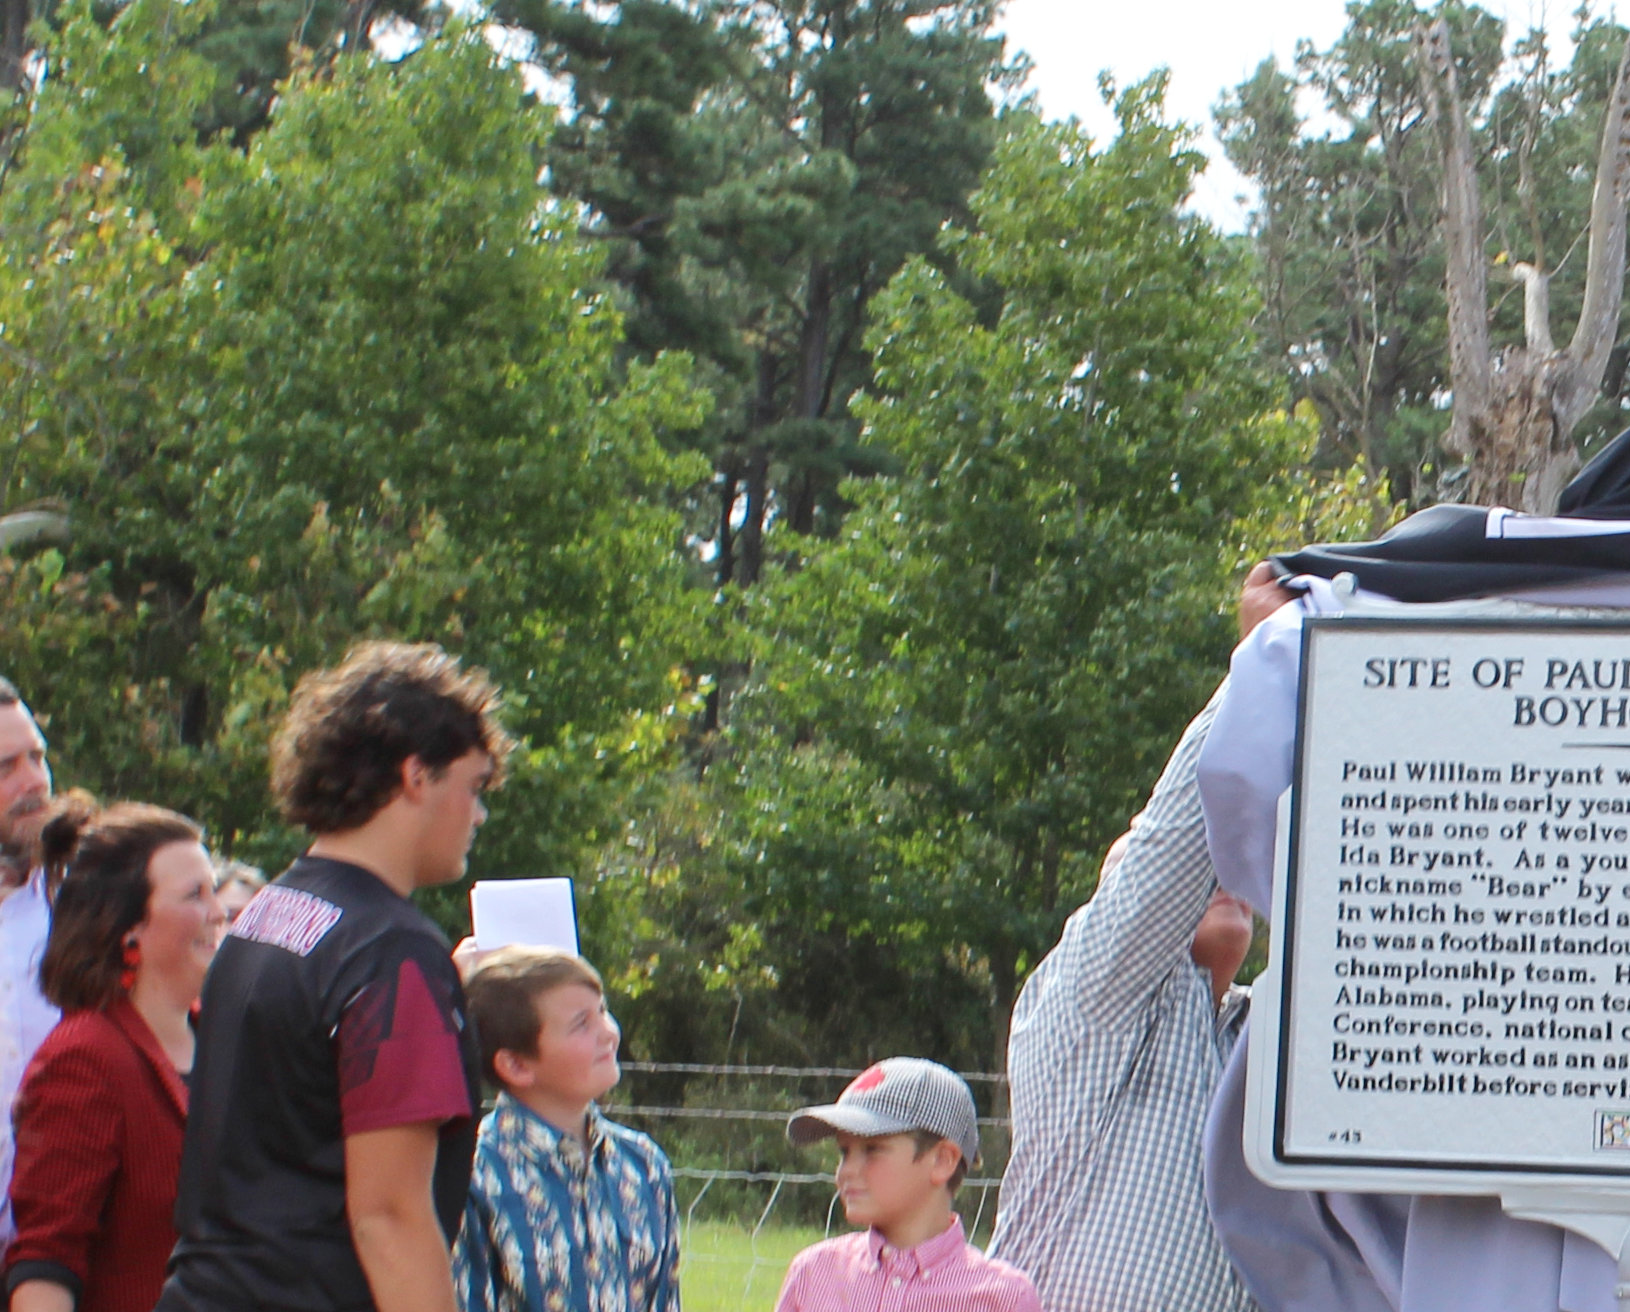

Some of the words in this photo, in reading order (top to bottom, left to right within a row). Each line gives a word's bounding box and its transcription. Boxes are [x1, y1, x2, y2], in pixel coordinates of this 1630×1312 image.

[1363, 656, 1450, 689] SITE
[1472, 657, 1524, 690] OF
[1342, 760, 1396, 782] Paul
[1405, 760, 1501, 784] William
[1510, 762, 1604, 790] Bryant
[1341, 789, 1386, 811] and
[1390, 790, 1459, 816] spent
[1464, 789, 1499, 813] his
[1503, 790, 1572, 820] early
[1341, 815, 1375, 838] He
[1386, 821, 1433, 839] was
[1443, 823, 1489, 840] one
[1499, 819, 1527, 841] of
[1538, 820, 1627, 843] twelve
[1339, 843, 1380, 867] Ida
[1389, 844, 1493, 873] Bryant.
[1513, 847, 1545, 870] As
[1555, 854, 1570, 870] a
[1338, 871, 1462, 896] nickname
[1471, 871, 1567, 899] "Bear"
[1576, 871, 1612, 903] by
[1338, 899, 1361, 922] in
[1369, 901, 1446, 924] which
[1453, 902, 1485, 925] he
[1493, 905, 1609, 928] wrestled
[1616, 912, 1630, 928] a
[1336, 927, 1367, 950] he
[1372, 934, 1416, 951] was
[1421, 935, 1434, 952] a
[1439, 930, 1536, 955] football
[1334, 955, 1515, 982] championship
[1524, 960, 1596, 985] team.
[1334, 986, 1452, 1010] Alabama,
[1462, 988, 1559, 1016] playing
[1564, 995, 1594, 1013] on
[1333, 1011, 1492, 1040] Conference,
[1504, 1017, 1612, 1042] national
[1331, 1040, 1423, 1070] Bryant
[1431, 1045, 1526, 1068] worked
[1532, 1051, 1558, 1069] as
[1565, 1052, 1595, 1070] an
[1332, 1068, 1467, 1095] Vanderbilt
[1471, 1072, 1557, 1097] before
